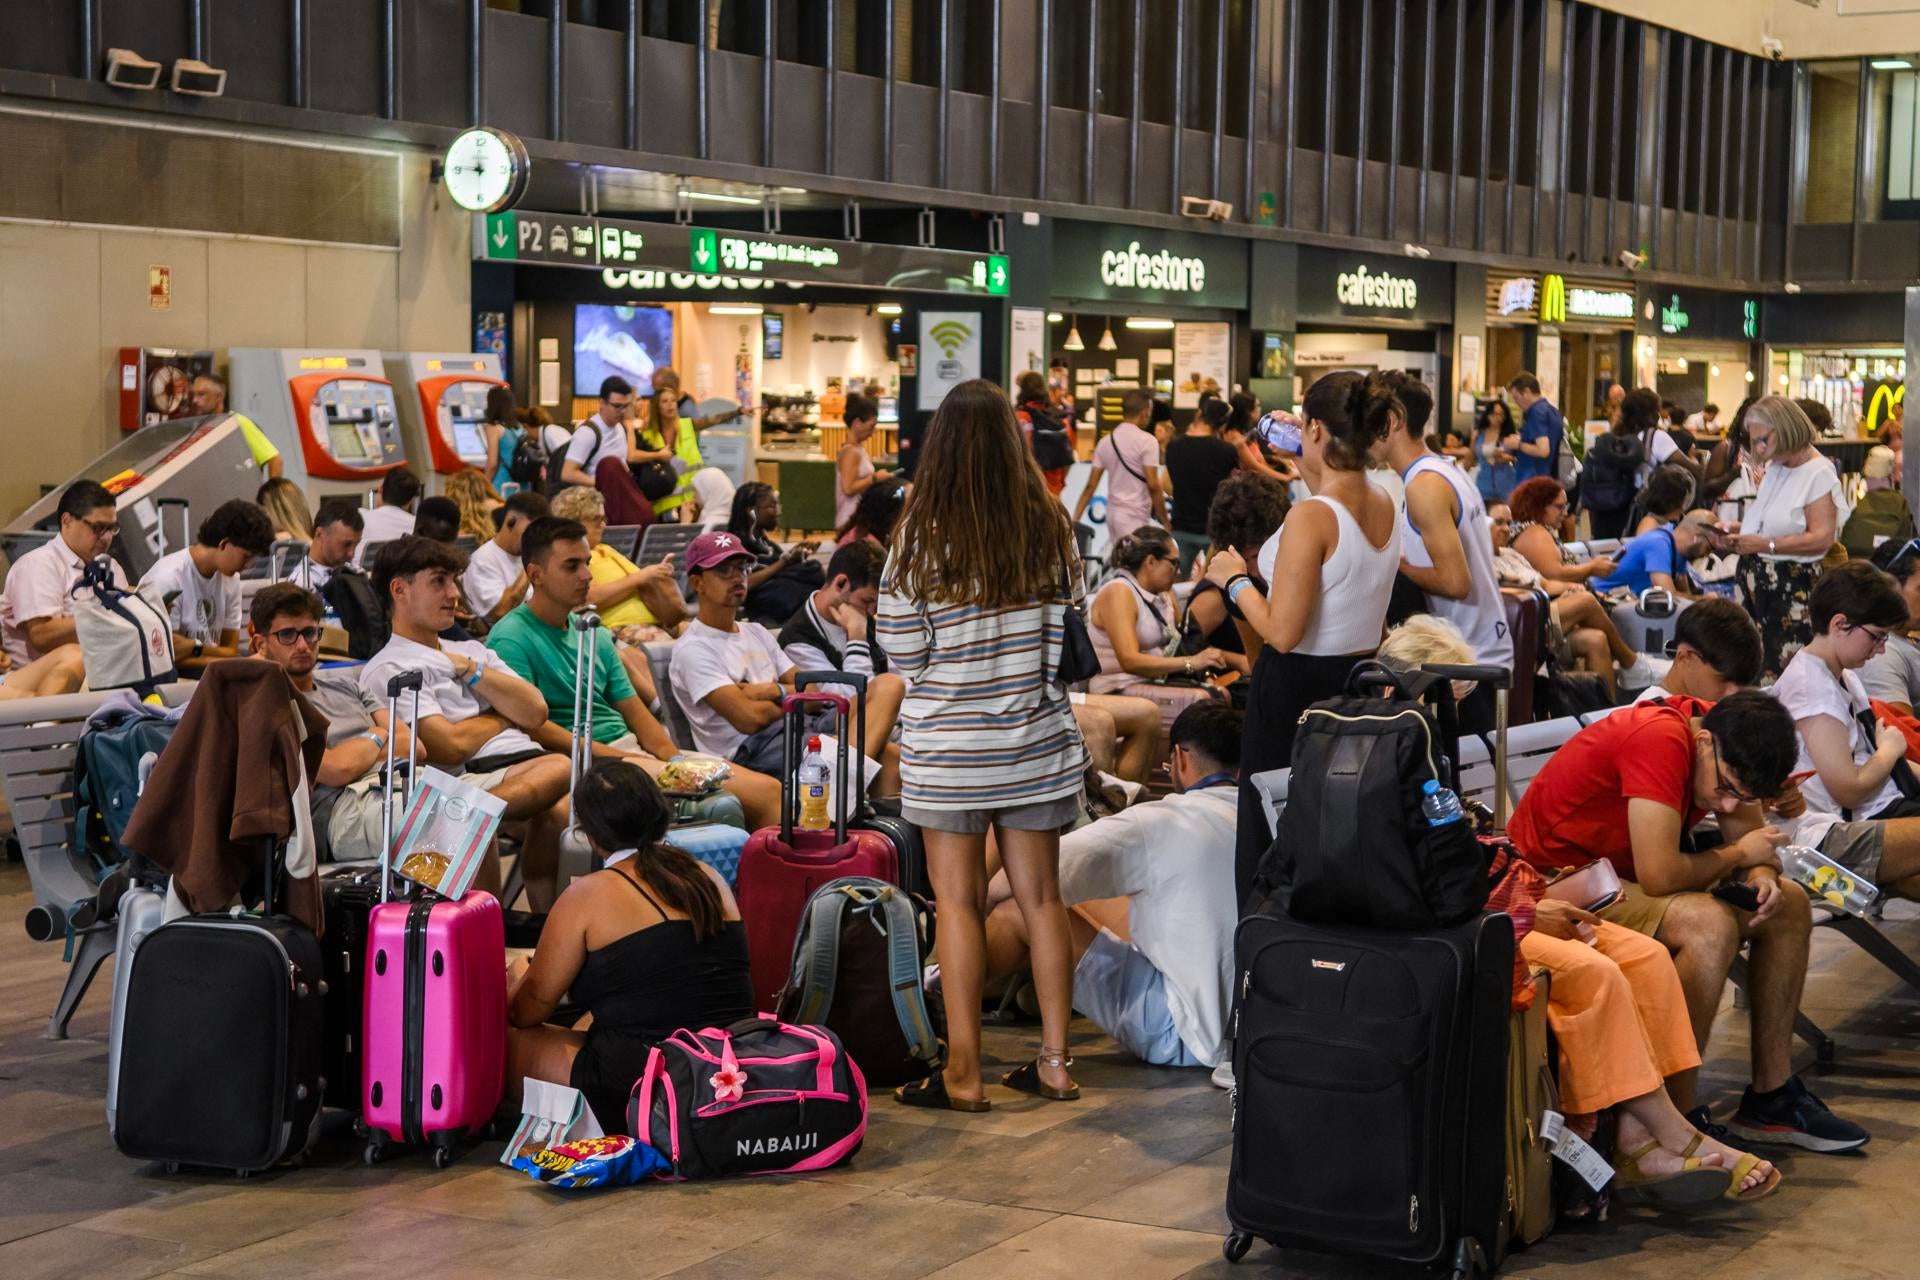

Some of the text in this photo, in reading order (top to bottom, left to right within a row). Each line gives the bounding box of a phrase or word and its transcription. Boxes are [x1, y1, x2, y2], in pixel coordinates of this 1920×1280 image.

[518, 220, 543, 252] P2
[1101, 240, 1205, 292] cafestore
[1337, 264, 1417, 310] cafestore
[737, 1131, 818, 1157] NABAIJI
